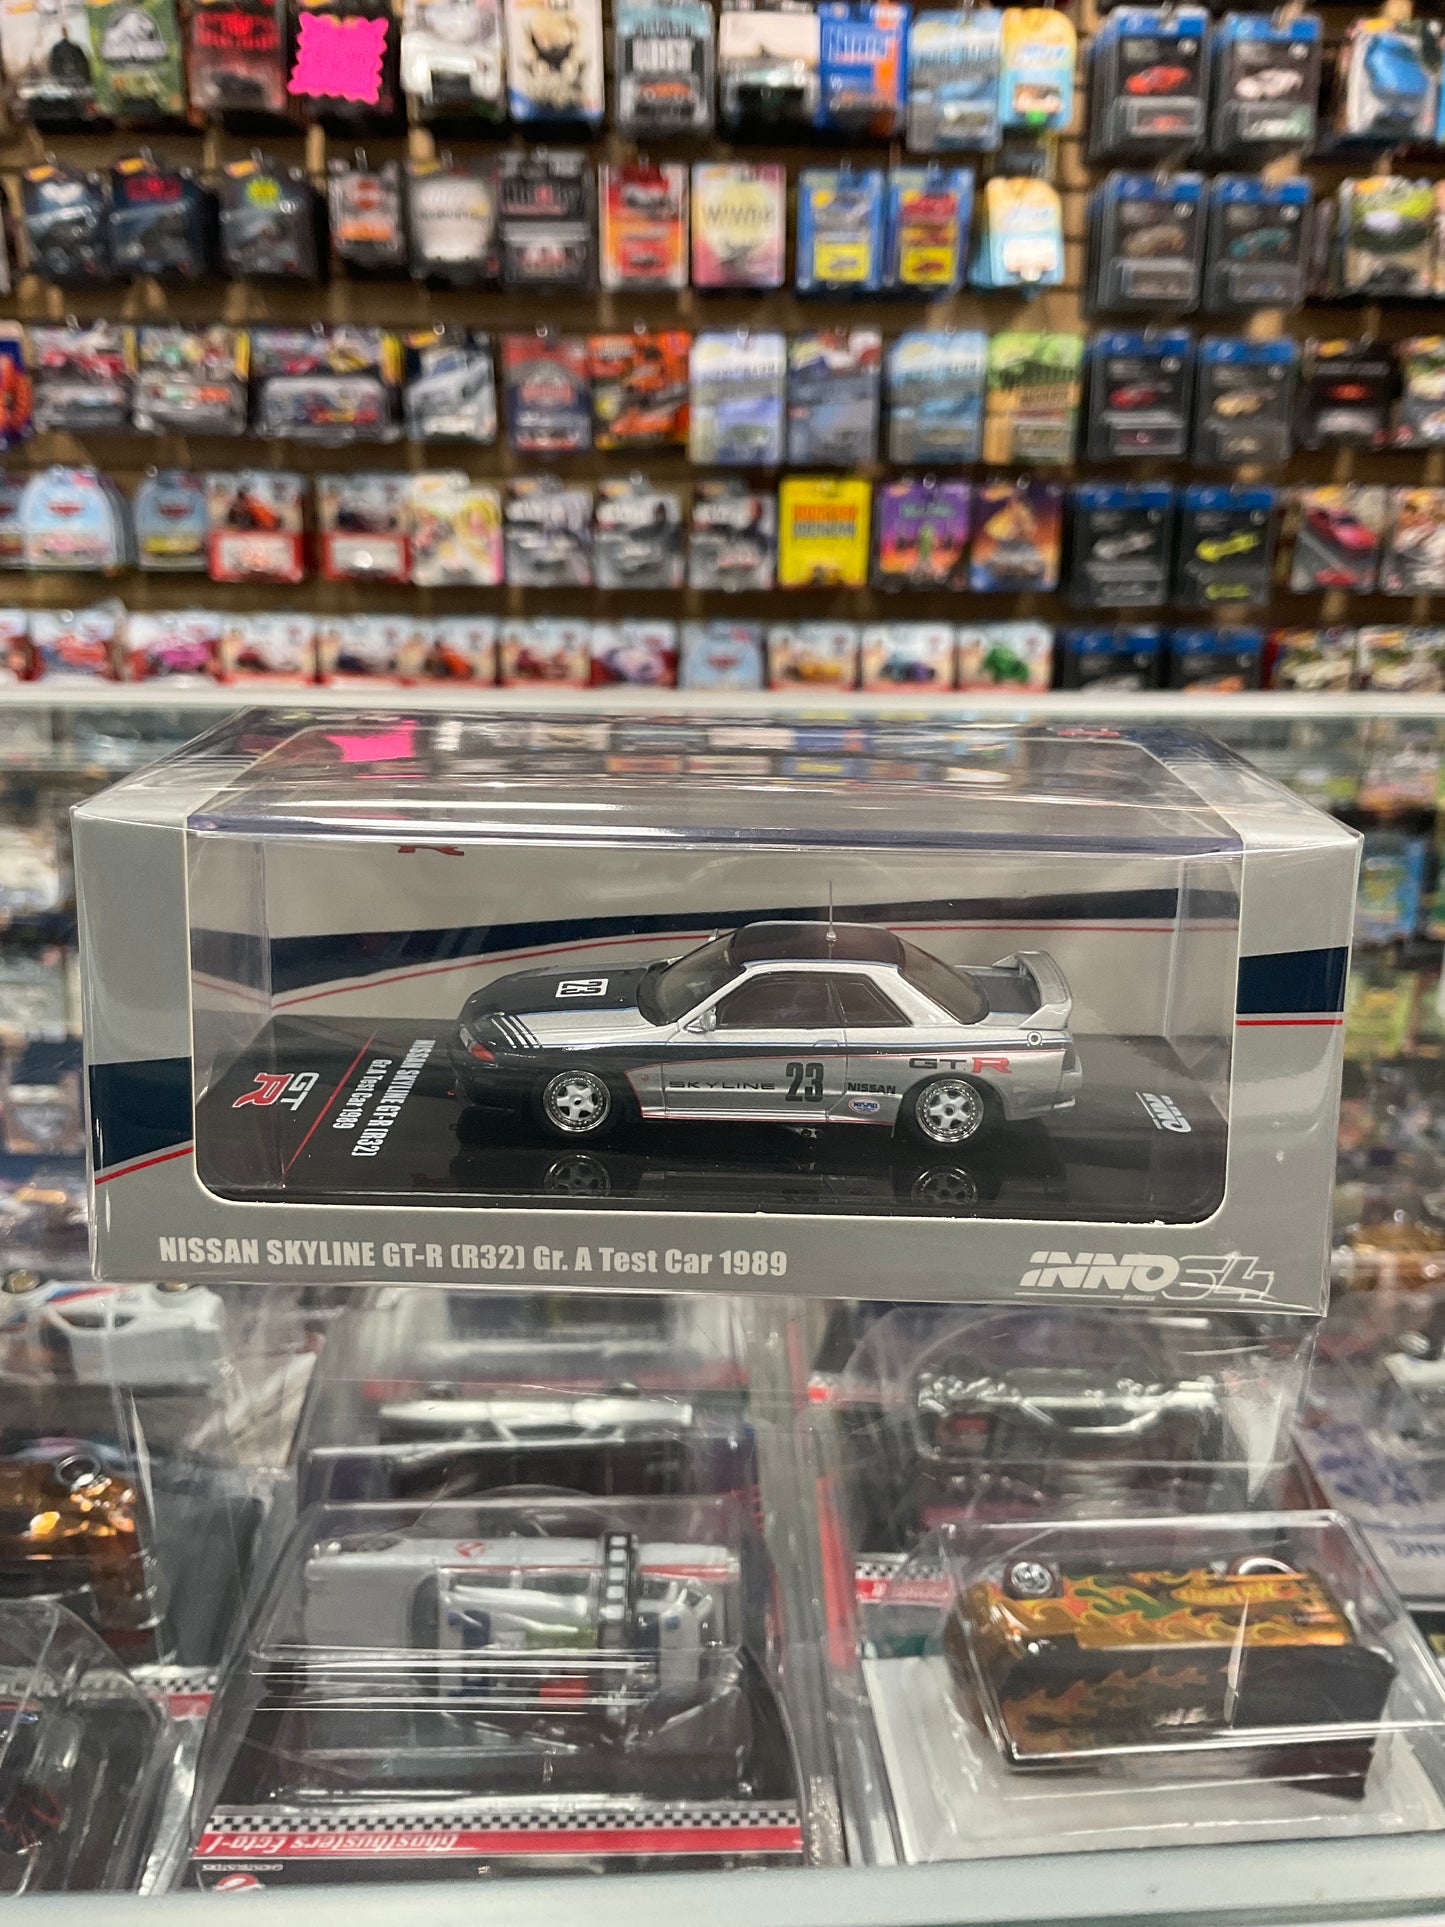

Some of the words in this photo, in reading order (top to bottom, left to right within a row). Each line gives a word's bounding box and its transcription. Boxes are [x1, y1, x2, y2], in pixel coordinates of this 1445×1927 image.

[401, 1039, 437, 1069] NISSAN
[355, 1075, 384, 1092] Test
[380, 1069, 421, 1104] SKYLINE
[669, 1080, 776, 1090] SKYLINE
[784, 1062, 825, 1102] 23
[847, 1082, 896, 1095] NISSAN
[346, 1093, 374, 1107] Car
[332, 1108, 364, 1130] 1989
[367, 1105, 402, 1127] GT-R
[351, 1128, 389, 1157] (R32)
[159, 1236, 260, 1264] NISSAN
[266, 1239, 376, 1267] SKYLINE
[382, 1242, 444, 1269] GT-R
[450, 1244, 526, 1270] (R32)
[533, 1245, 569, 1271] Gr.
[574, 1246, 593, 1272] A
[598, 1247, 658, 1273] Test
[664, 1248, 713, 1275] Car
[719, 1250, 788, 1276] 1989
[290, 1833, 460, 1853] Ghostbusters
